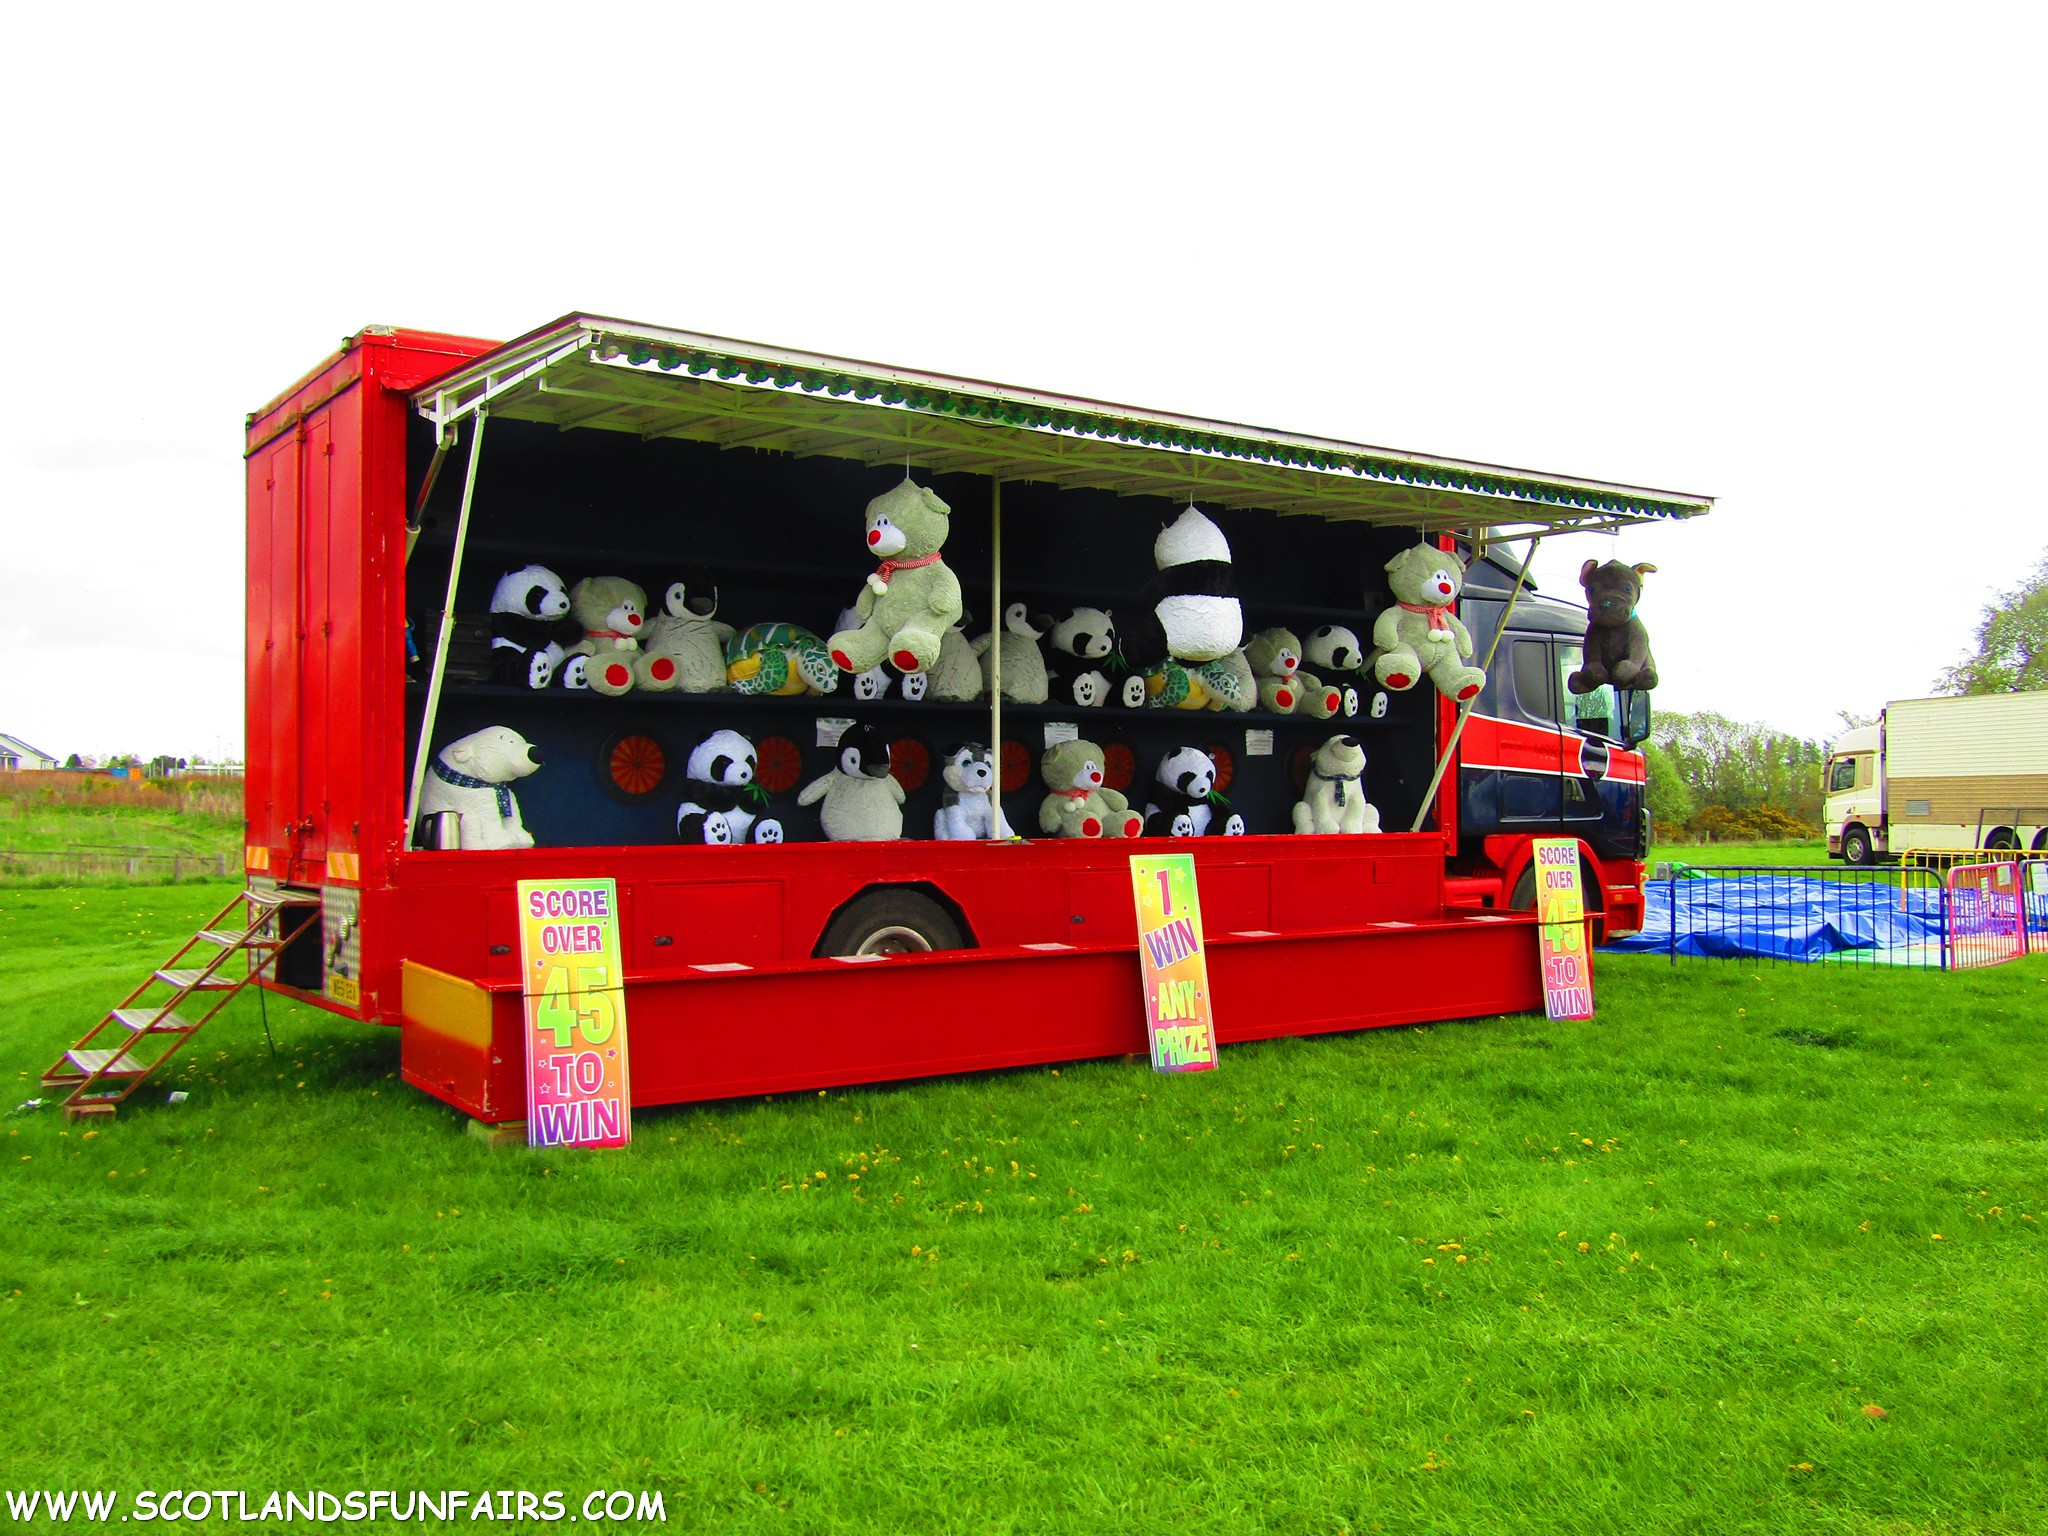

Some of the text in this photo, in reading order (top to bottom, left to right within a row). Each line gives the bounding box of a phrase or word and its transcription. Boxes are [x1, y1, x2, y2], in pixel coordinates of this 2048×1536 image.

[1539, 846, 1576, 865] SCORE
[1156, 869, 1174, 917] 1
[1545, 870, 1574, 890] OVER
[530, 889, 609, 918] SCORE
[542, 924, 603, 954] OVER
[1143, 916, 1200, 971] WIN
[1544, 898, 1581, 953] 45
[1552, 955, 1578, 985] TO
[537, 966, 616, 1048] 45
[1157, 980, 1196, 1021] ANY
[1549, 987, 1588, 1018] WIN
[1154, 1024, 1212, 1067] PRIZE
[550, 1051, 604, 1096] TO
[538, 1099, 621, 1146] WIN
